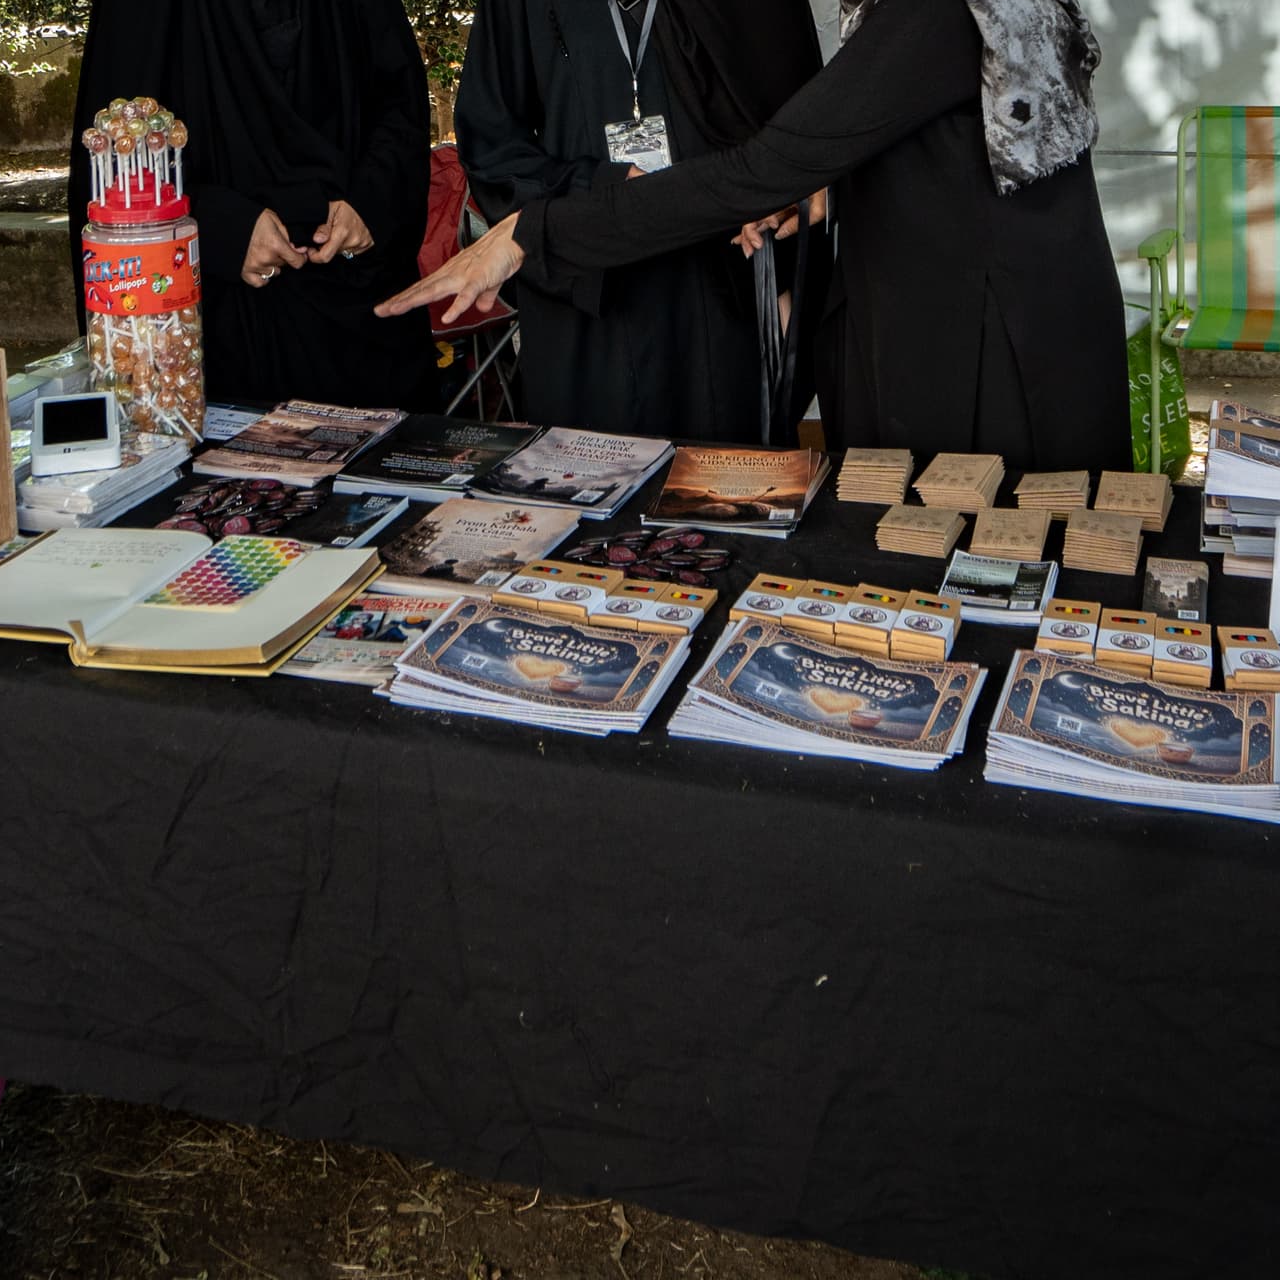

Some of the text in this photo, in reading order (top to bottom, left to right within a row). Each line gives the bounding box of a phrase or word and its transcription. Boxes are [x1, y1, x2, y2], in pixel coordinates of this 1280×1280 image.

[109, 277, 148, 293] Lollipops
[456, 518, 537, 534] From Karbala
[511, 628, 617, 658] Brave Little
[515, 639, 597, 665] Sakina
[801, 656, 907, 692] Brave Little
[808, 671, 892, 699] Sakina
[1089, 684, 1205, 721] Brave Little
[1102, 698, 1192, 730] Sakina
